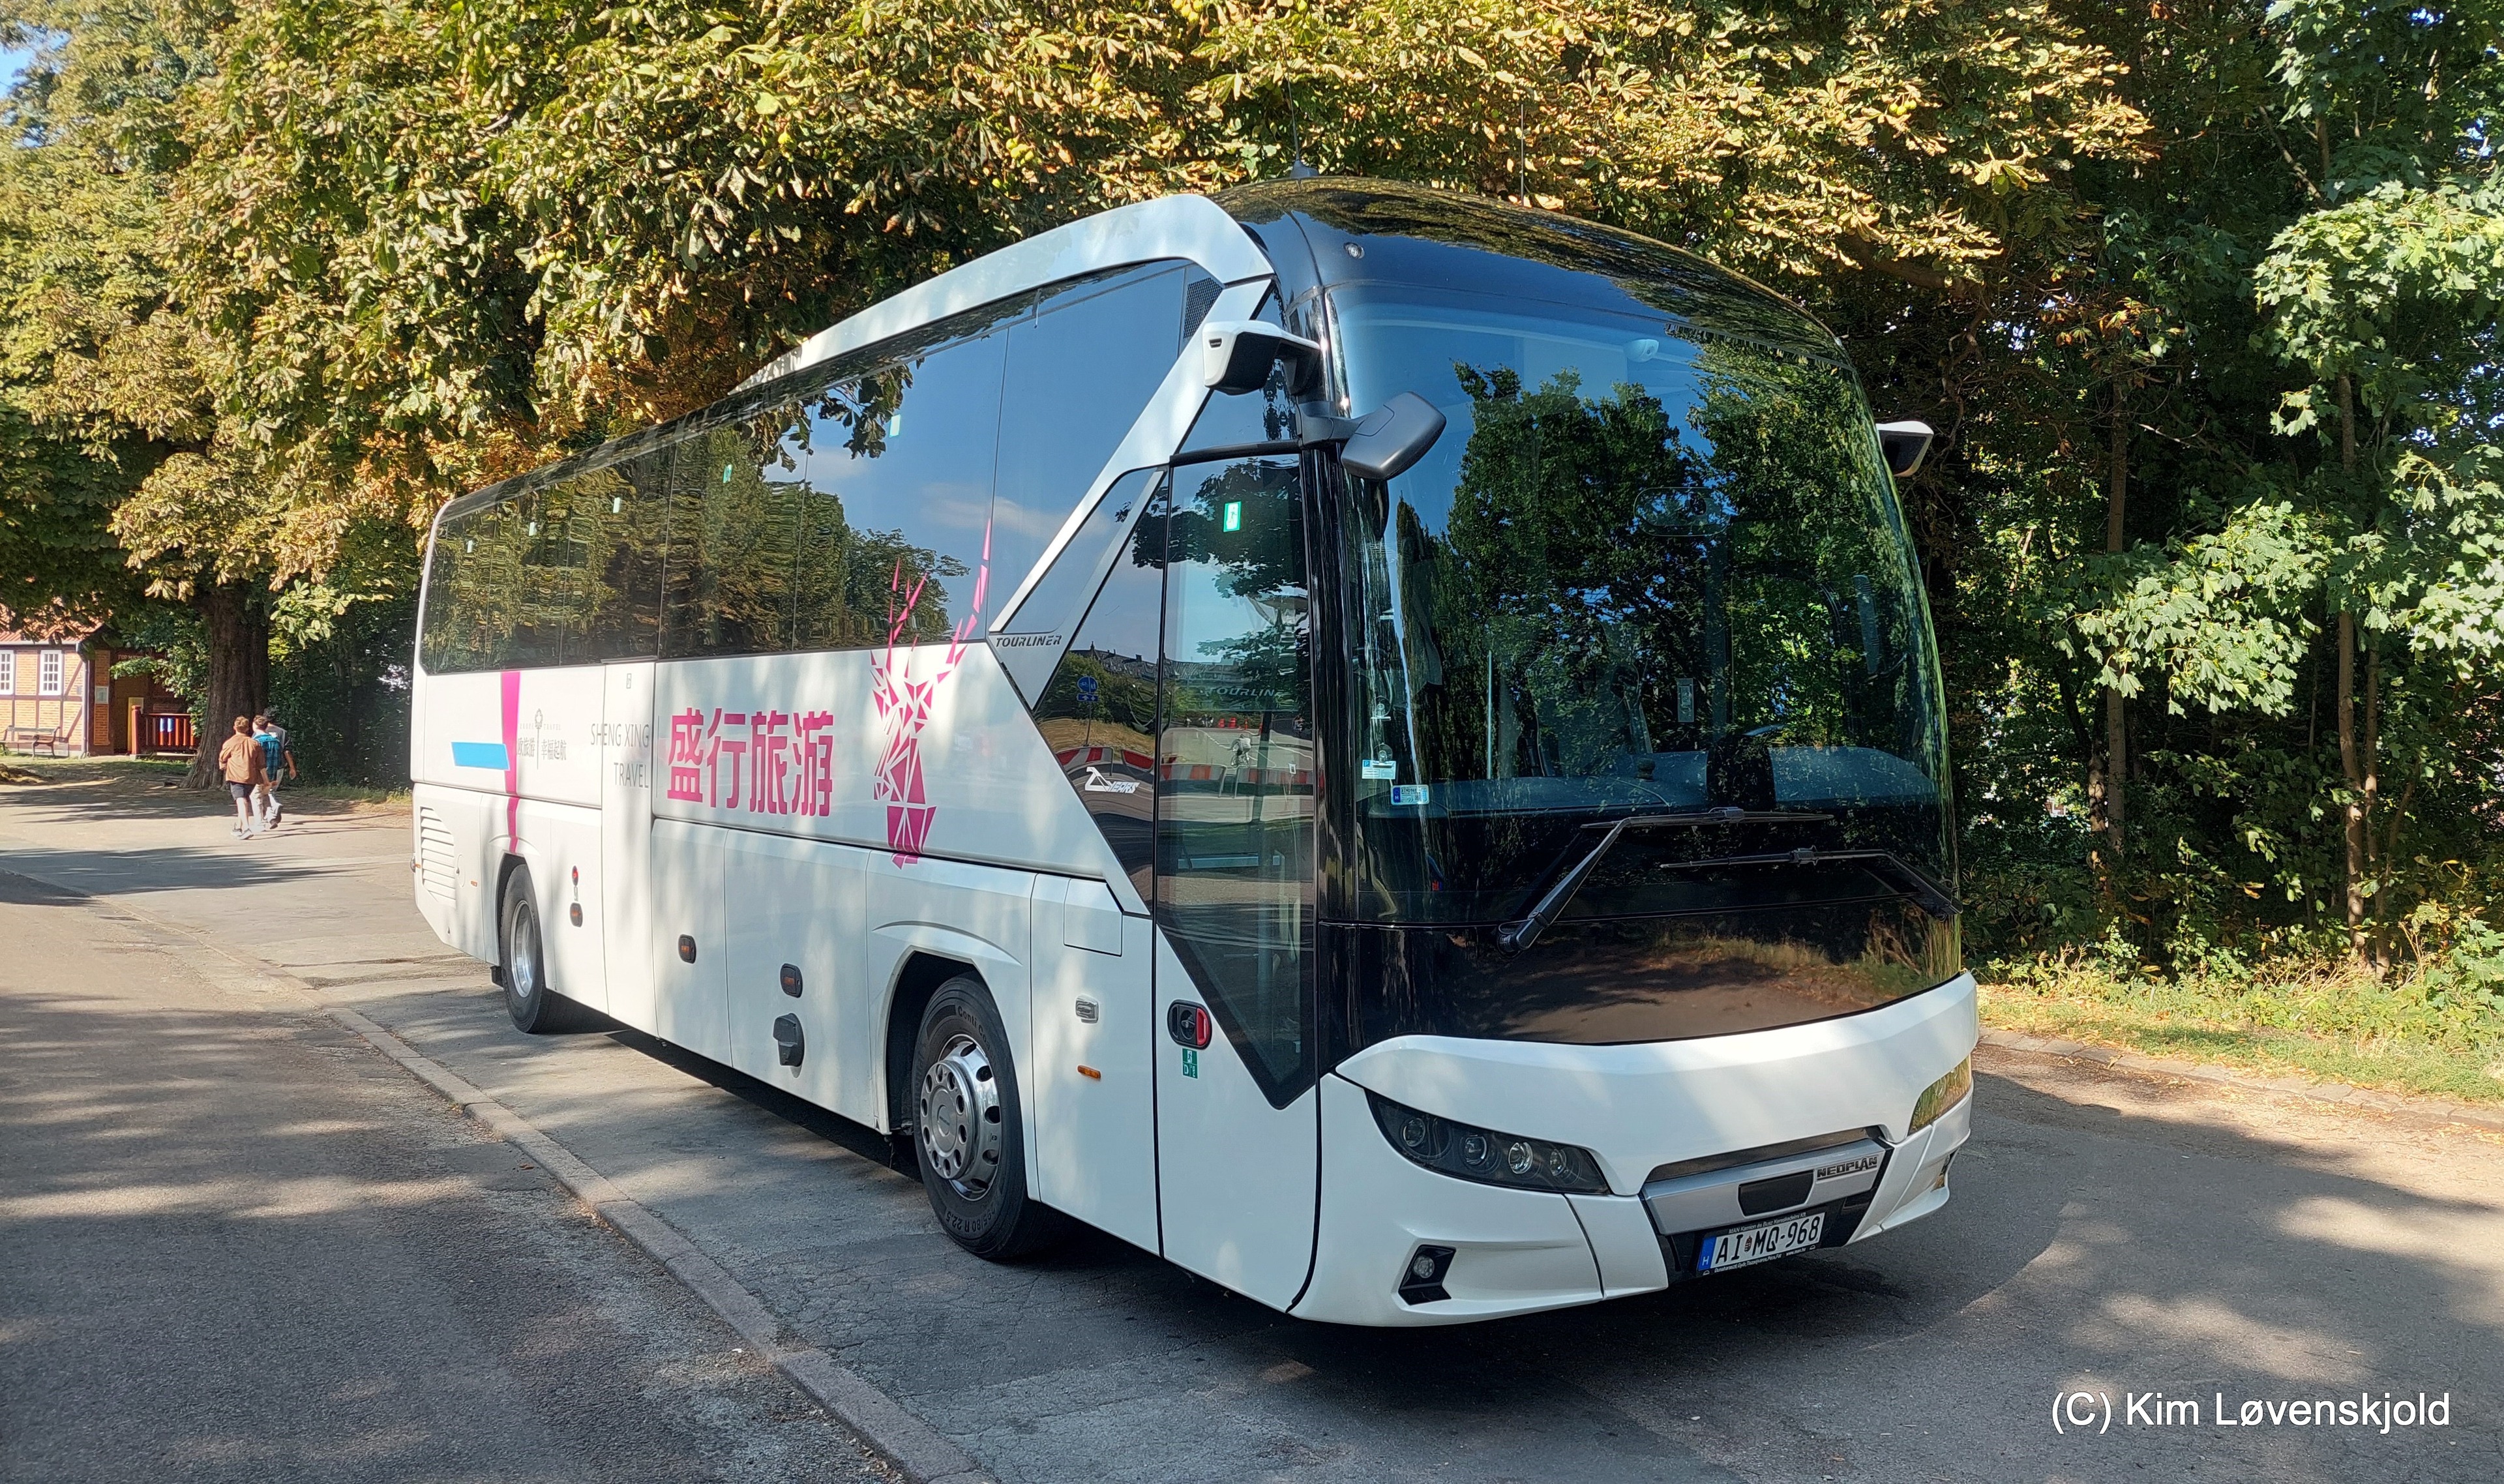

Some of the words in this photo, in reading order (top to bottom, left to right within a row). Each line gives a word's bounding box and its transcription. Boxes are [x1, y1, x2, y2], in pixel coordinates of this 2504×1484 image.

[996, 634, 1062, 647] TOURLINER
[590, 723, 621, 747] SHENG
[624, 724, 649, 748] XING
[668, 707, 833, 816] 盛行旅游
[614, 762, 649, 788] TRAVEL
[958, 1005, 977, 1028] Conti
[1817, 1157, 1877, 1179] NEOPLAN
[1716, 1234, 1743, 1264] AI
[1752, 1216, 1821, 1256] MQ-968
[1702, 1256, 1710, 1266] H
